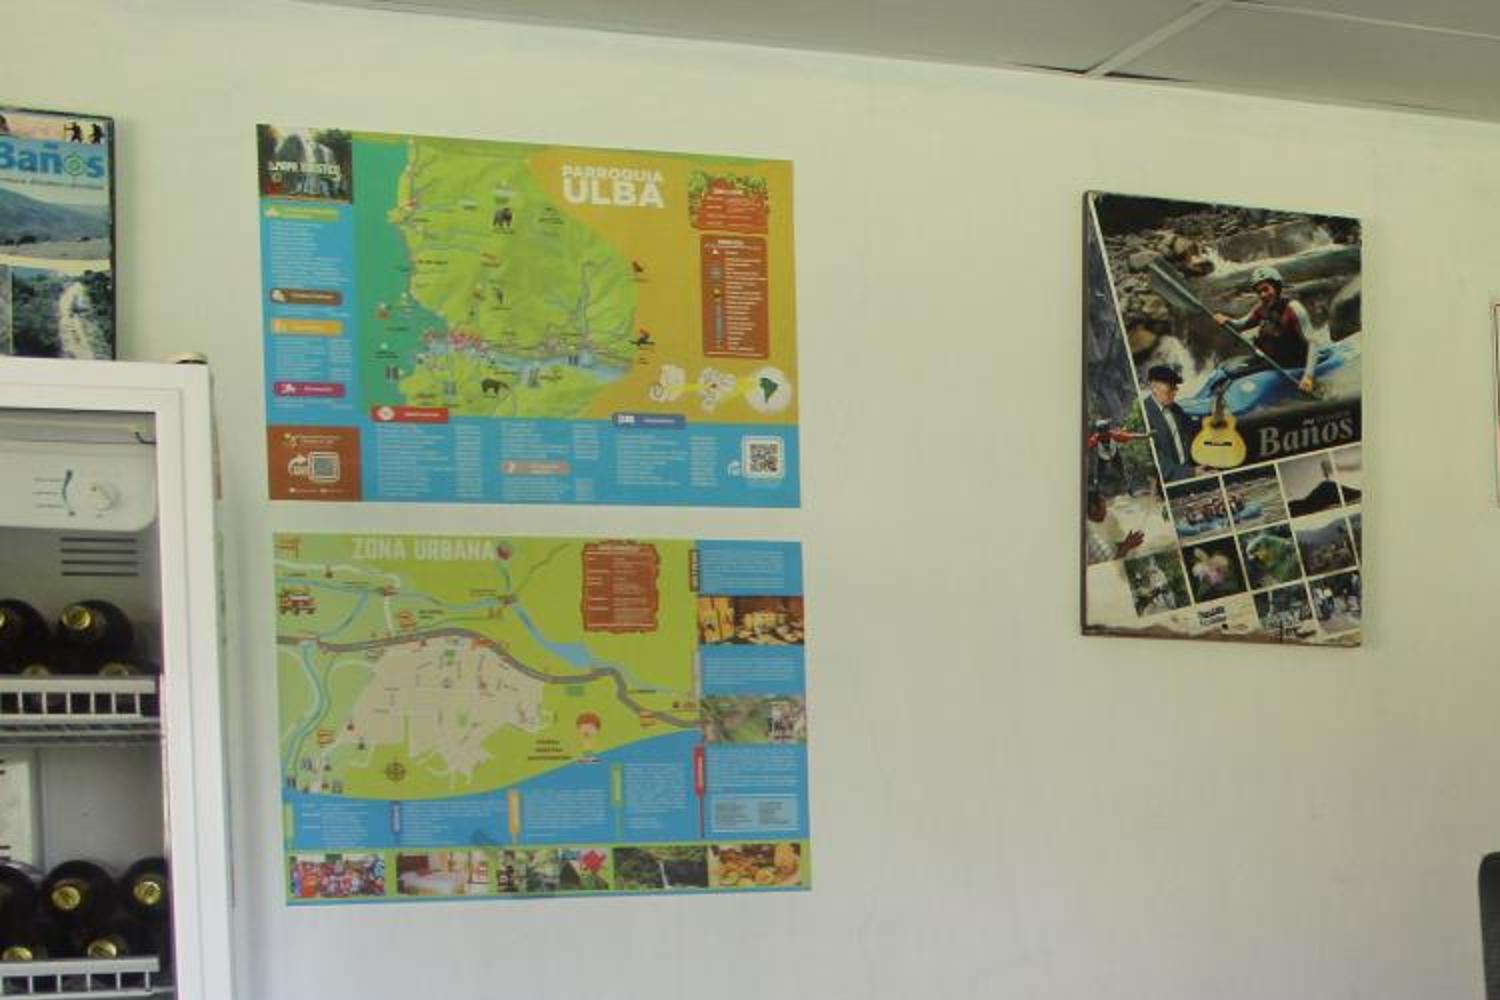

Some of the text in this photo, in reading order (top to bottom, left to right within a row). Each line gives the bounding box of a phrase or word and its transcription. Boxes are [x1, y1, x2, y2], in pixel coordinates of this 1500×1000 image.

[563, 177, 664, 208] ULBA
[1259, 417, 1354, 456] Baños
[352, 537, 496, 561] ZONA URBANA
